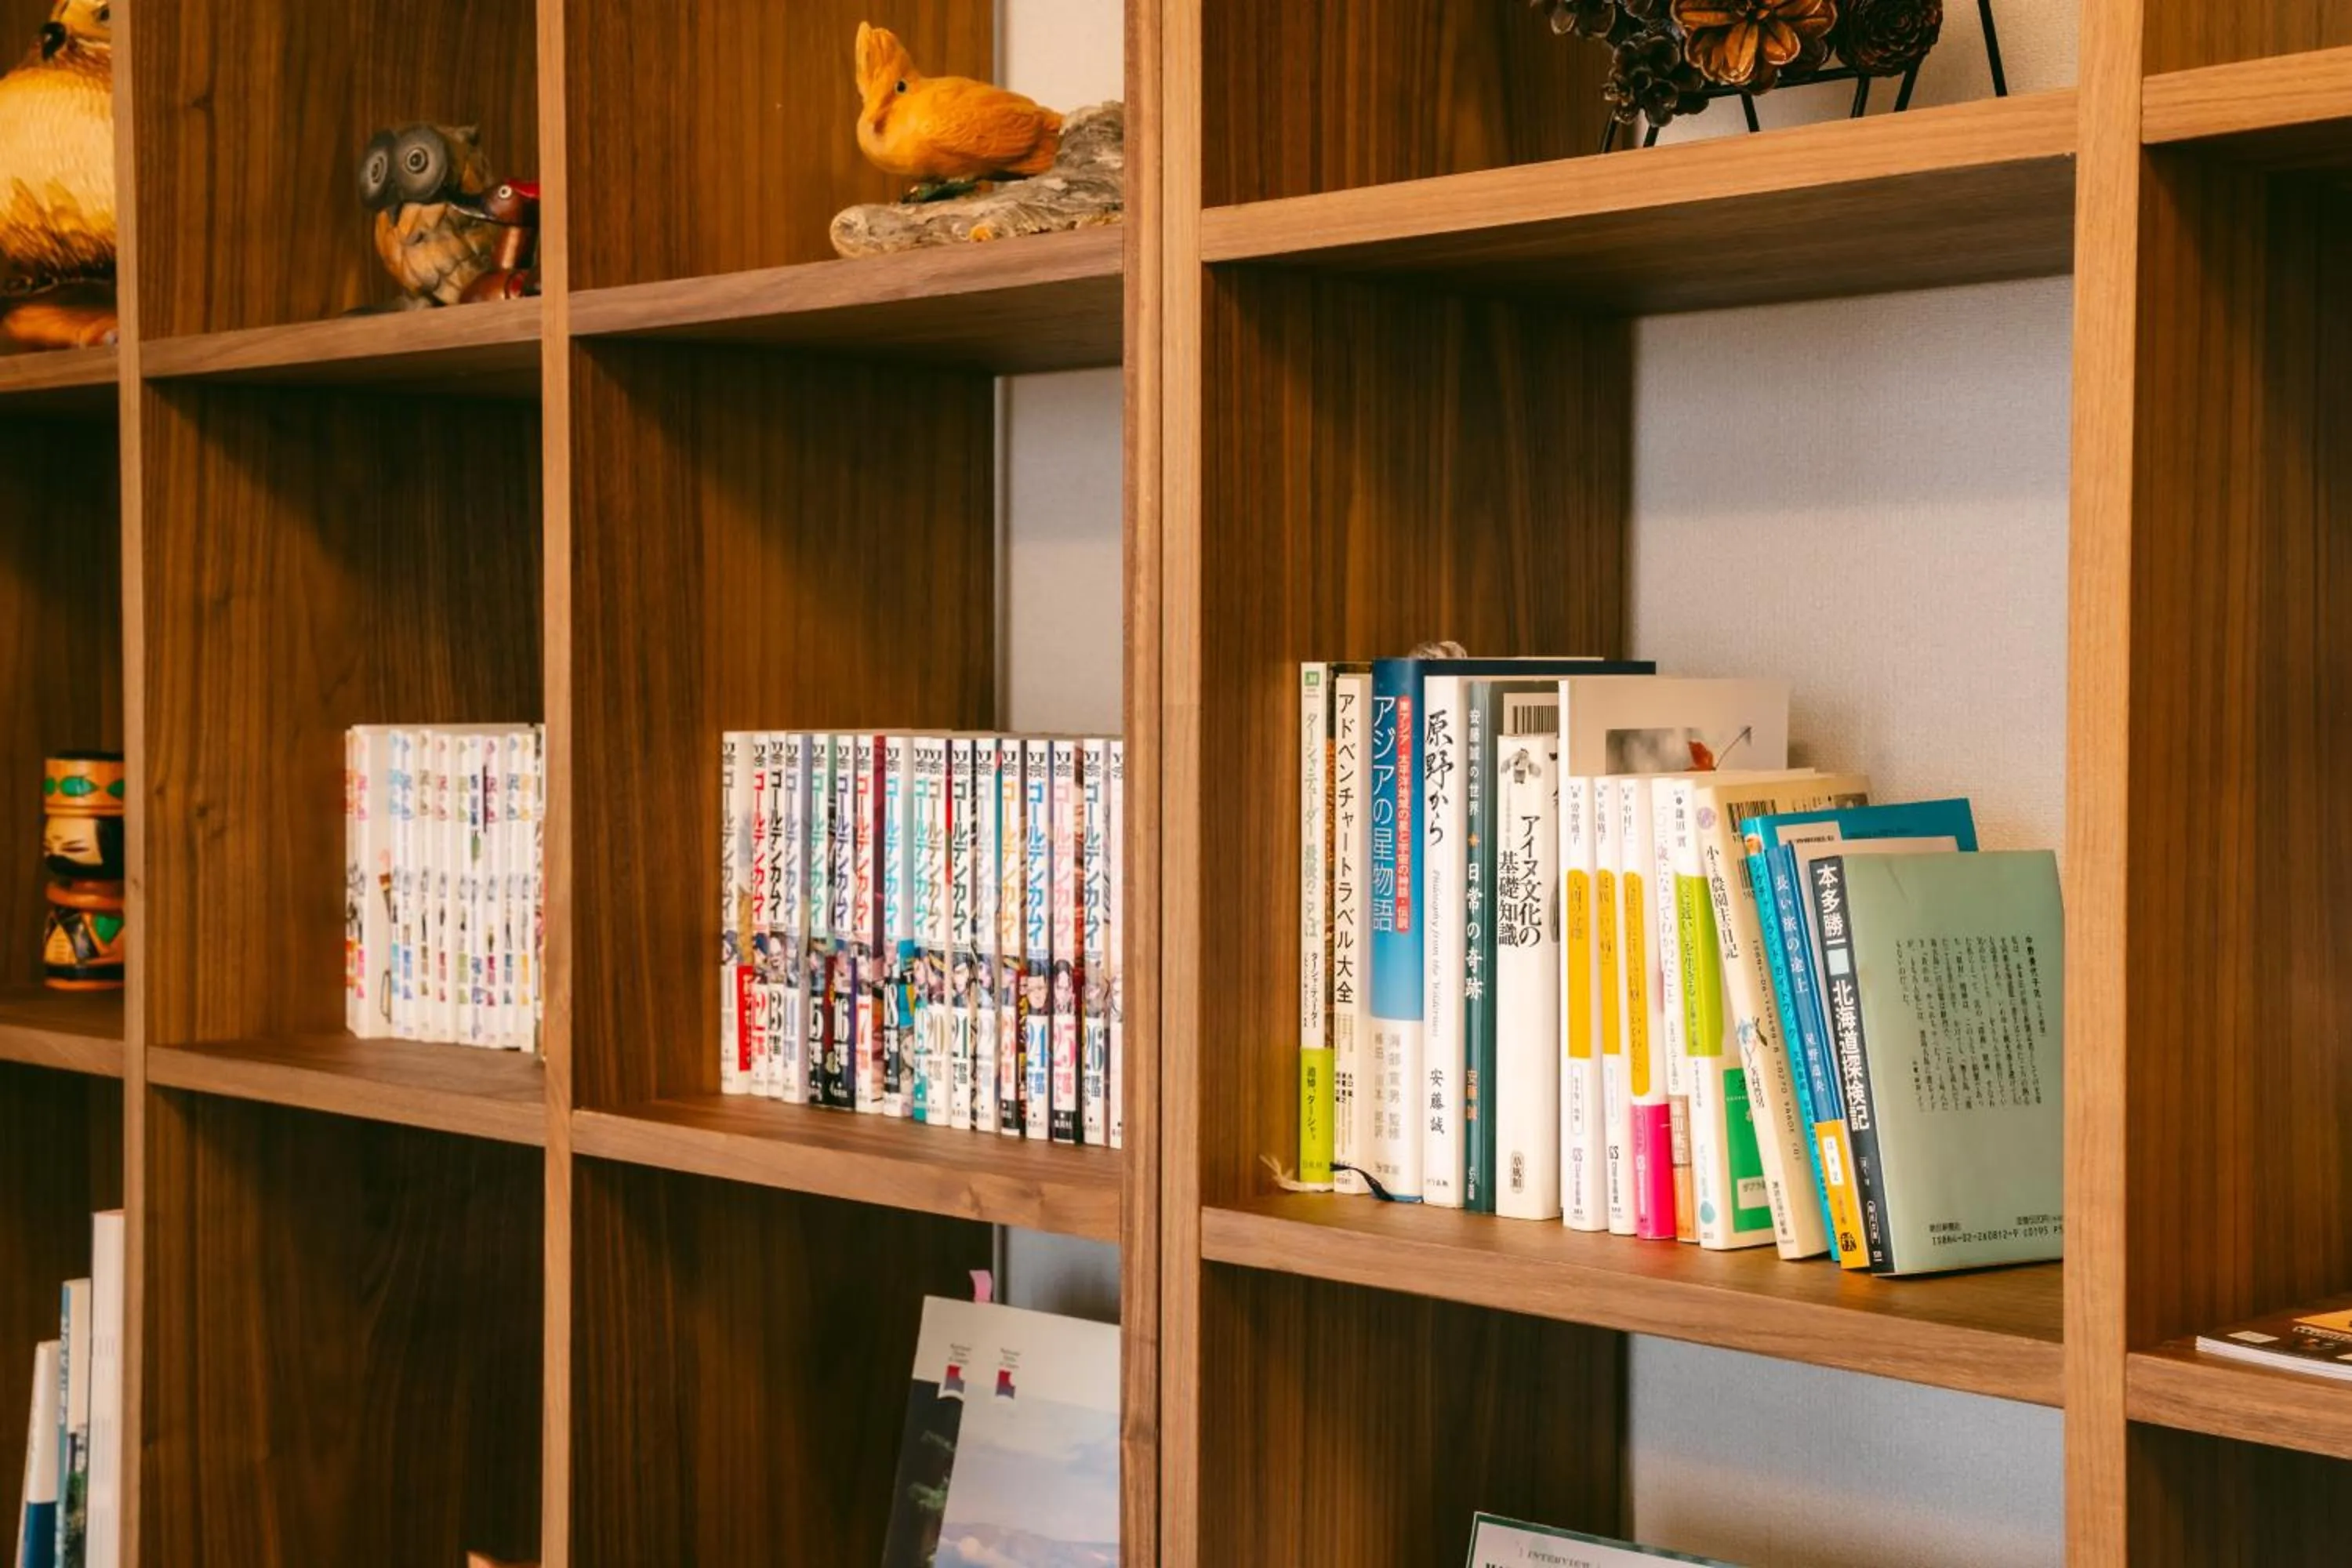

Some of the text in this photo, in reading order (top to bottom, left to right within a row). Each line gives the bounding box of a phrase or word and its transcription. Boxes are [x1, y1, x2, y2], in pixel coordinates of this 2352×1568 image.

[770, 771, 782, 920] ゴールデンカムイ
[1337, 694, 1355, 1004] アドベンチャートラベル大全
[1373, 696, 1396, 931] アジアの星物語
[1425, 709, 1454, 846] 原野から
[837, 775, 849, 929] ゴールデンカムイ
[953, 780, 968, 940] ゴールデンカムイ
[1028, 781, 1045, 947] ゴールデンカムイ
[1083, 782, 1100, 949] ゴールデンカムイ
[1498, 851, 1519, 947] 基礎知識
[1519, 815, 1541, 947] アイヌ文化の
[1465, 863, 1483, 1001] 日常の奇跡
[1777, 874, 1808, 994] 長い旅の途上
[1817, 865, 1870, 1132] 本多勝一 北海道探検記
[1026, 1024, 1045, 1068] 24
[1430, 1068, 1445, 1134] 安藤誠
[1528, 1550, 1590, 1568] INTERVIEW
